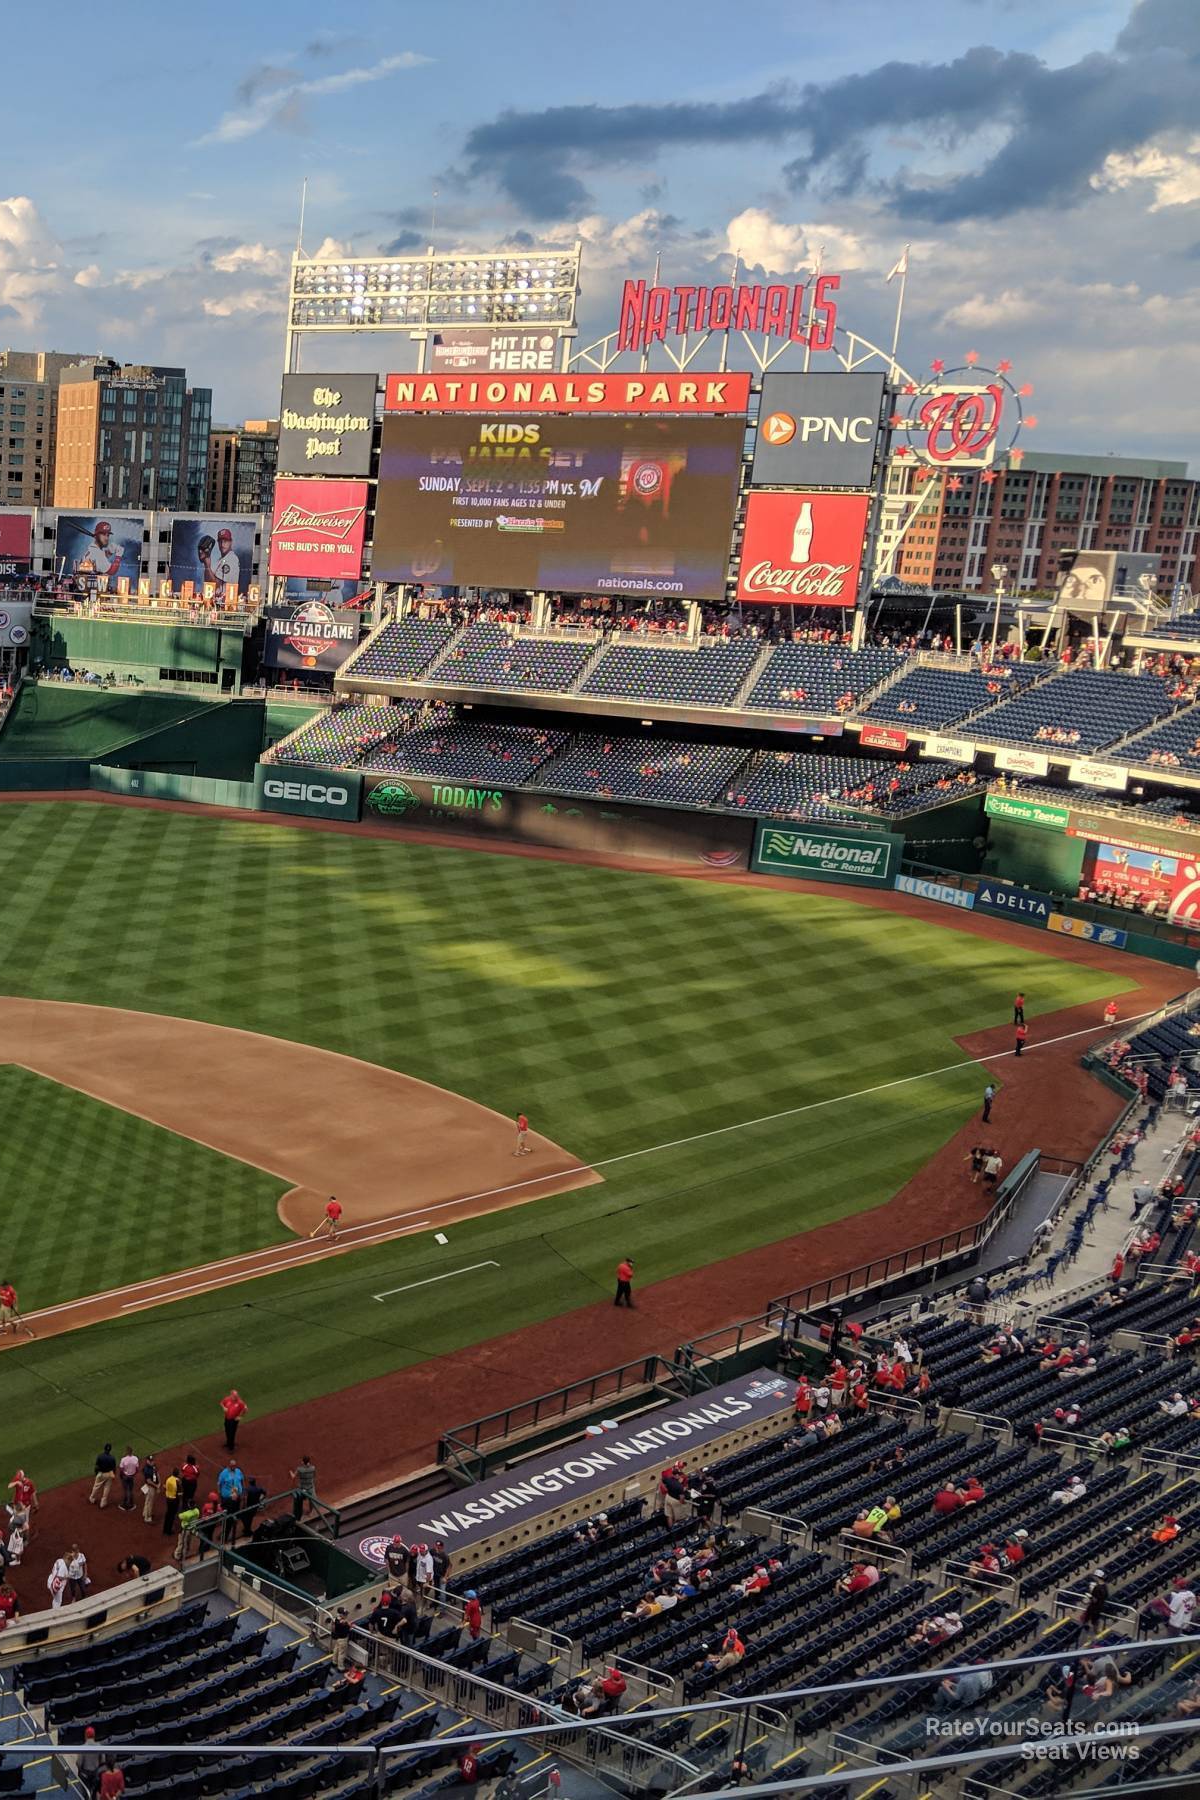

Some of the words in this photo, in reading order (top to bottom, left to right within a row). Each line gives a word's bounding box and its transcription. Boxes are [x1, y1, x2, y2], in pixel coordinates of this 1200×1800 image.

[617, 275, 840, 351] NATIONALS
[490, 337, 519, 350] HIT
[521, 336, 538, 350] IT
[489, 351, 554, 370] HERE
[313, 387, 342, 408] The
[397, 382, 606, 403] NATIONALS
[626, 382, 728, 403] PARK
[282, 408, 370, 435] Washington
[800, 416, 873, 444] PNC
[480, 423, 540, 444] KIDS
[305, 437, 342, 460] Post
[419, 476, 464, 493] SUNDAY,
[542, 480, 559, 495] PM
[452, 496, 469, 506] FIRST
[470, 497, 492, 507] 10,000
[493, 498, 510, 507] FANS
[511, 498, 527, 508] AGES
[544, 499, 566, 509] UNDER
[281, 511, 353, 528] Budweiser
[450, 518, 482, 528] PRESENTED
[484, 519, 493, 528] BY
[278, 541, 295, 551] THIS
[296, 542, 319, 552] BUD'S
[320, 543, 336, 553] FOR
[337, 544, 355, 554] YOU.
[597, 577, 684, 591] nationals.com
[744, 560, 854, 596] Coca-Cola
[272, 620, 292, 636] ALL
[294, 622, 322, 636] STAR
[324, 624, 354, 639] GAME
[264, 780, 348, 806] GEICO
[432, 785, 504, 812] TODAY'S
[999, 803, 1032, 818] Harris
[1033, 808, 1066, 824] Teeter
[1077, 819, 1098, 830] 6:30
[792, 838, 882, 864] National
[821, 860, 838, 869] Car
[841, 862, 875, 874] Rental
[915, 882, 968, 906] KOCH
[996, 892, 1046, 916] DELTA
[417, 1451, 616, 1538] WASHINGTON
[603, 1395, 752, 1467] NATIONALS
[381, 1617, 388, 1627] 7
